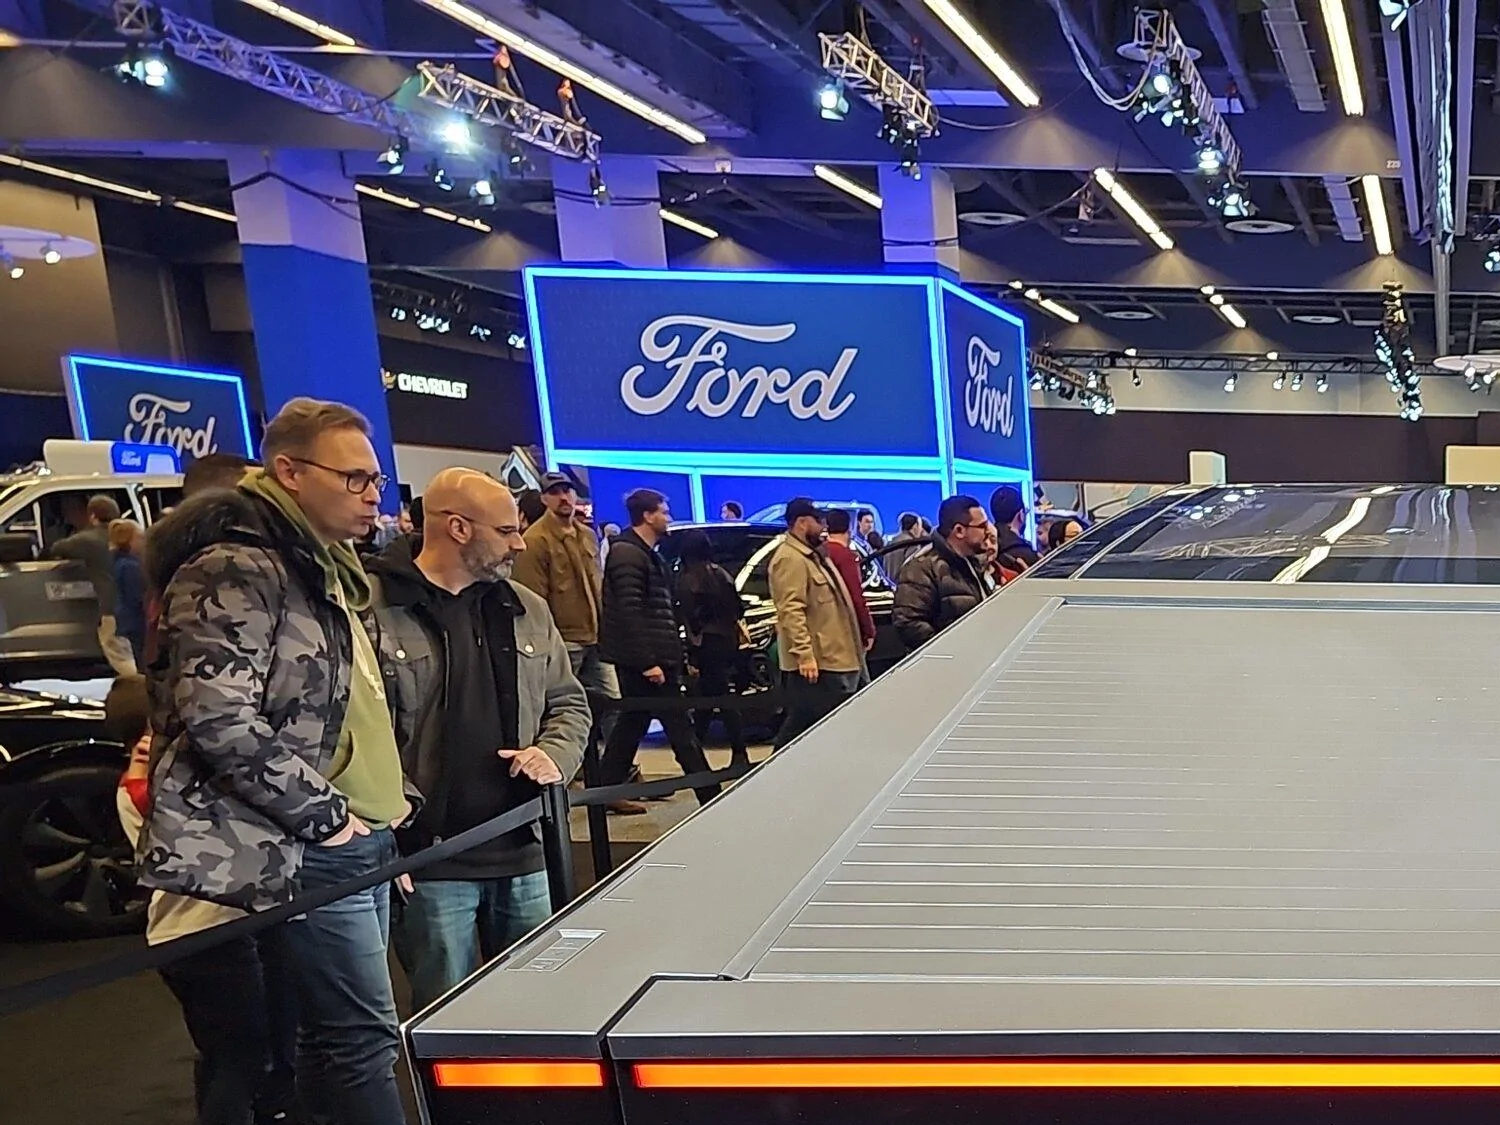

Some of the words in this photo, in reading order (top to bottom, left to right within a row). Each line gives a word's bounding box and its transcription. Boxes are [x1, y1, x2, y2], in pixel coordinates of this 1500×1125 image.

[398, 373, 468, 398] CHEVROLET
[620, 315, 858, 421] Ford
[964, 336, 1015, 438] Ford
